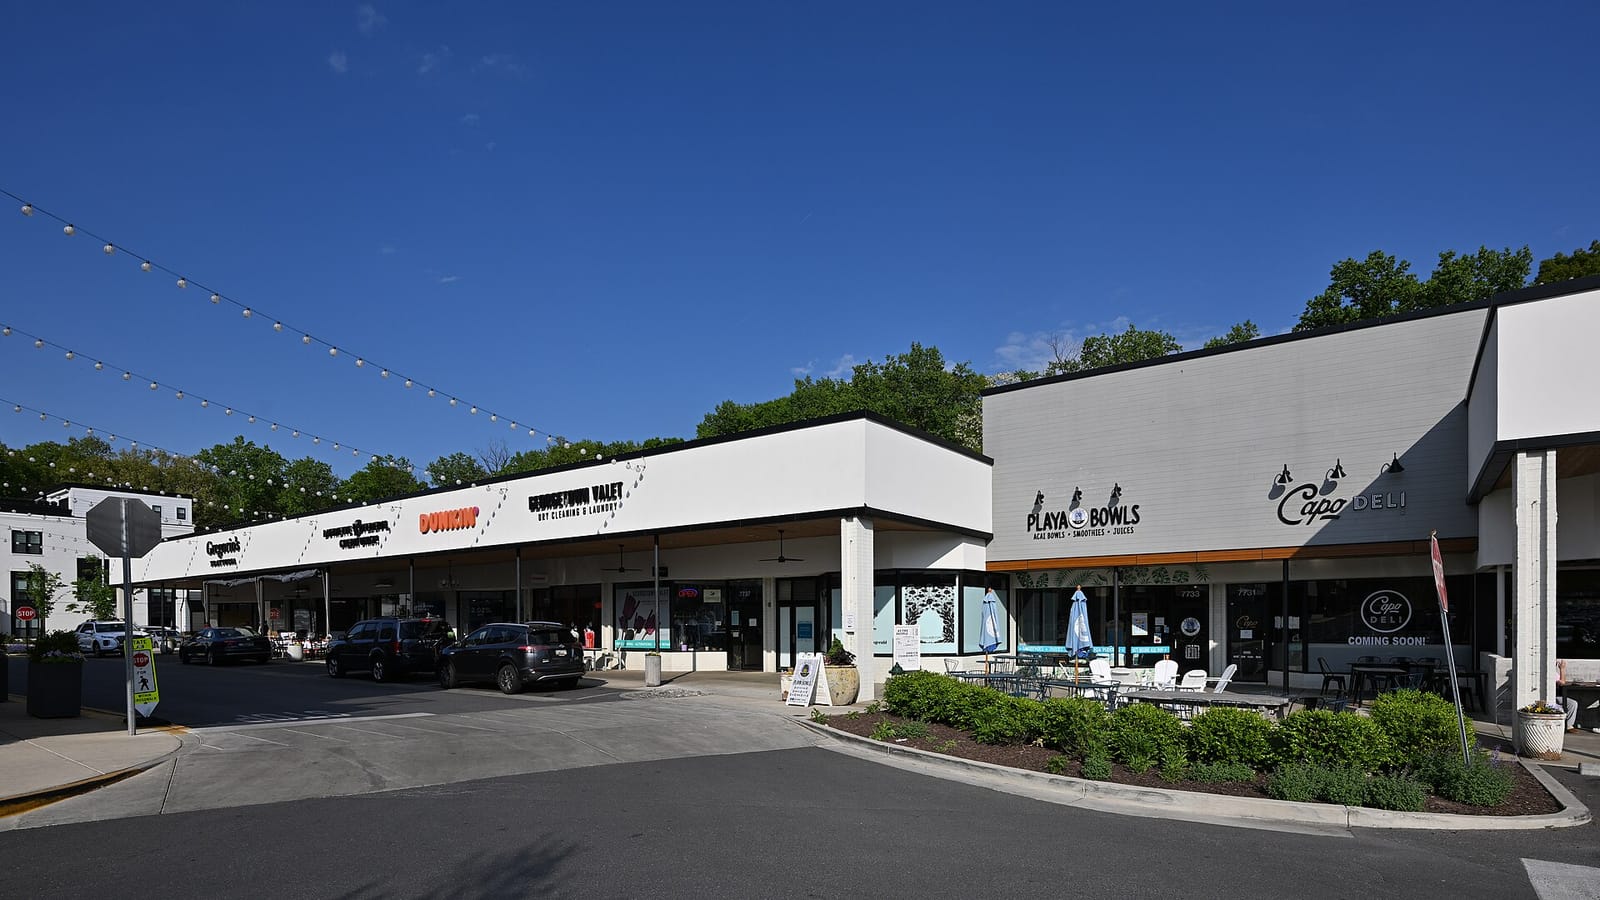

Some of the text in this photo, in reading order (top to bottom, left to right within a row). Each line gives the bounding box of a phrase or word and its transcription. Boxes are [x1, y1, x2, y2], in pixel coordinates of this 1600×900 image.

[591, 482, 623, 503] VALET
[538, 502, 618, 521] DRY CLEANING & LAUNDRY
[1277, 483, 1406, 526] Capo DELI
[1027, 504, 1140, 532] PLAYA BOWLS
[1033, 526, 1134, 540] ACAI BOWLS SMOOTHIES JUICES
[1238, 589, 1256, 597] 7731
[1369, 595, 1402, 615] Capo
[1236, 615, 1259, 629] Capo
[1370, 615, 1403, 624] DELI
[1348, 636, 1426, 646] COMING SOON!
